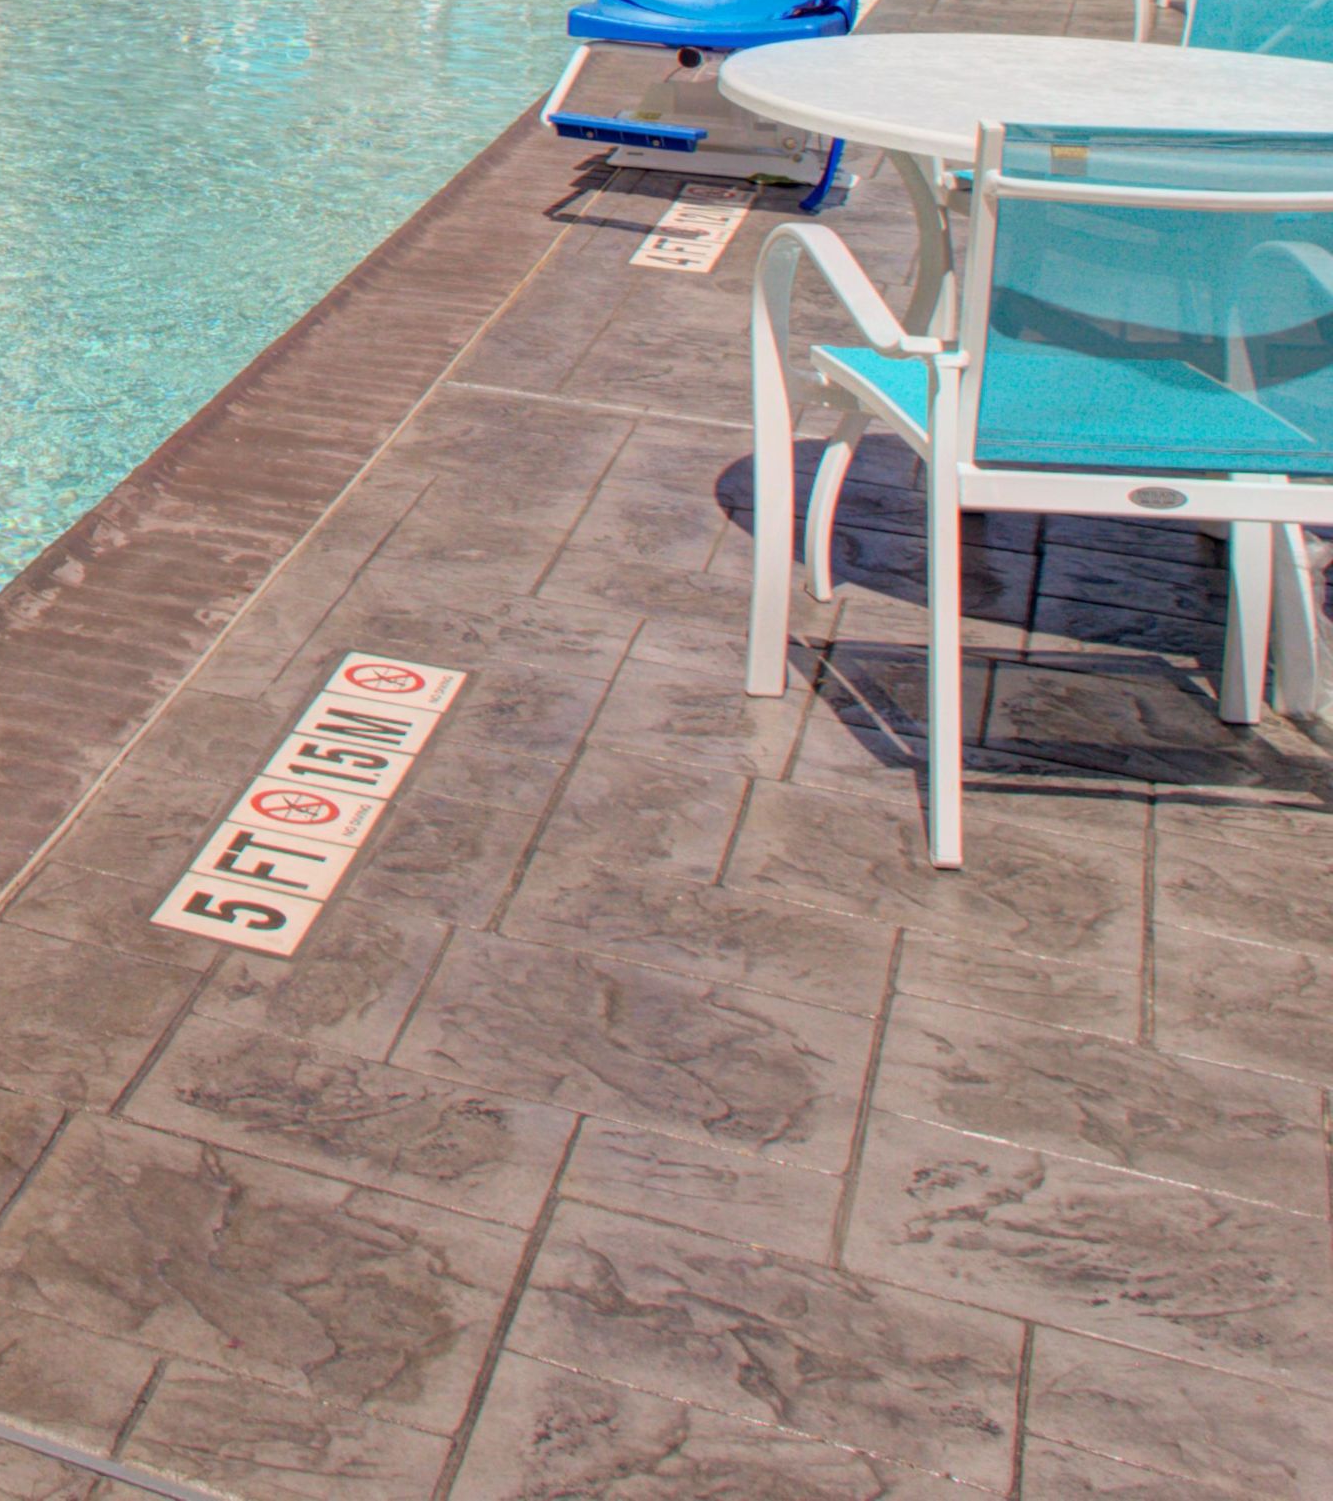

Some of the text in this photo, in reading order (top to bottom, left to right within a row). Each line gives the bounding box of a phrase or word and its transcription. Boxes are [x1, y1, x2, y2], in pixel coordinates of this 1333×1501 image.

[653, 237, 712, 256] FT
[182, 707, 413, 932] 5 FT 1.5 M
